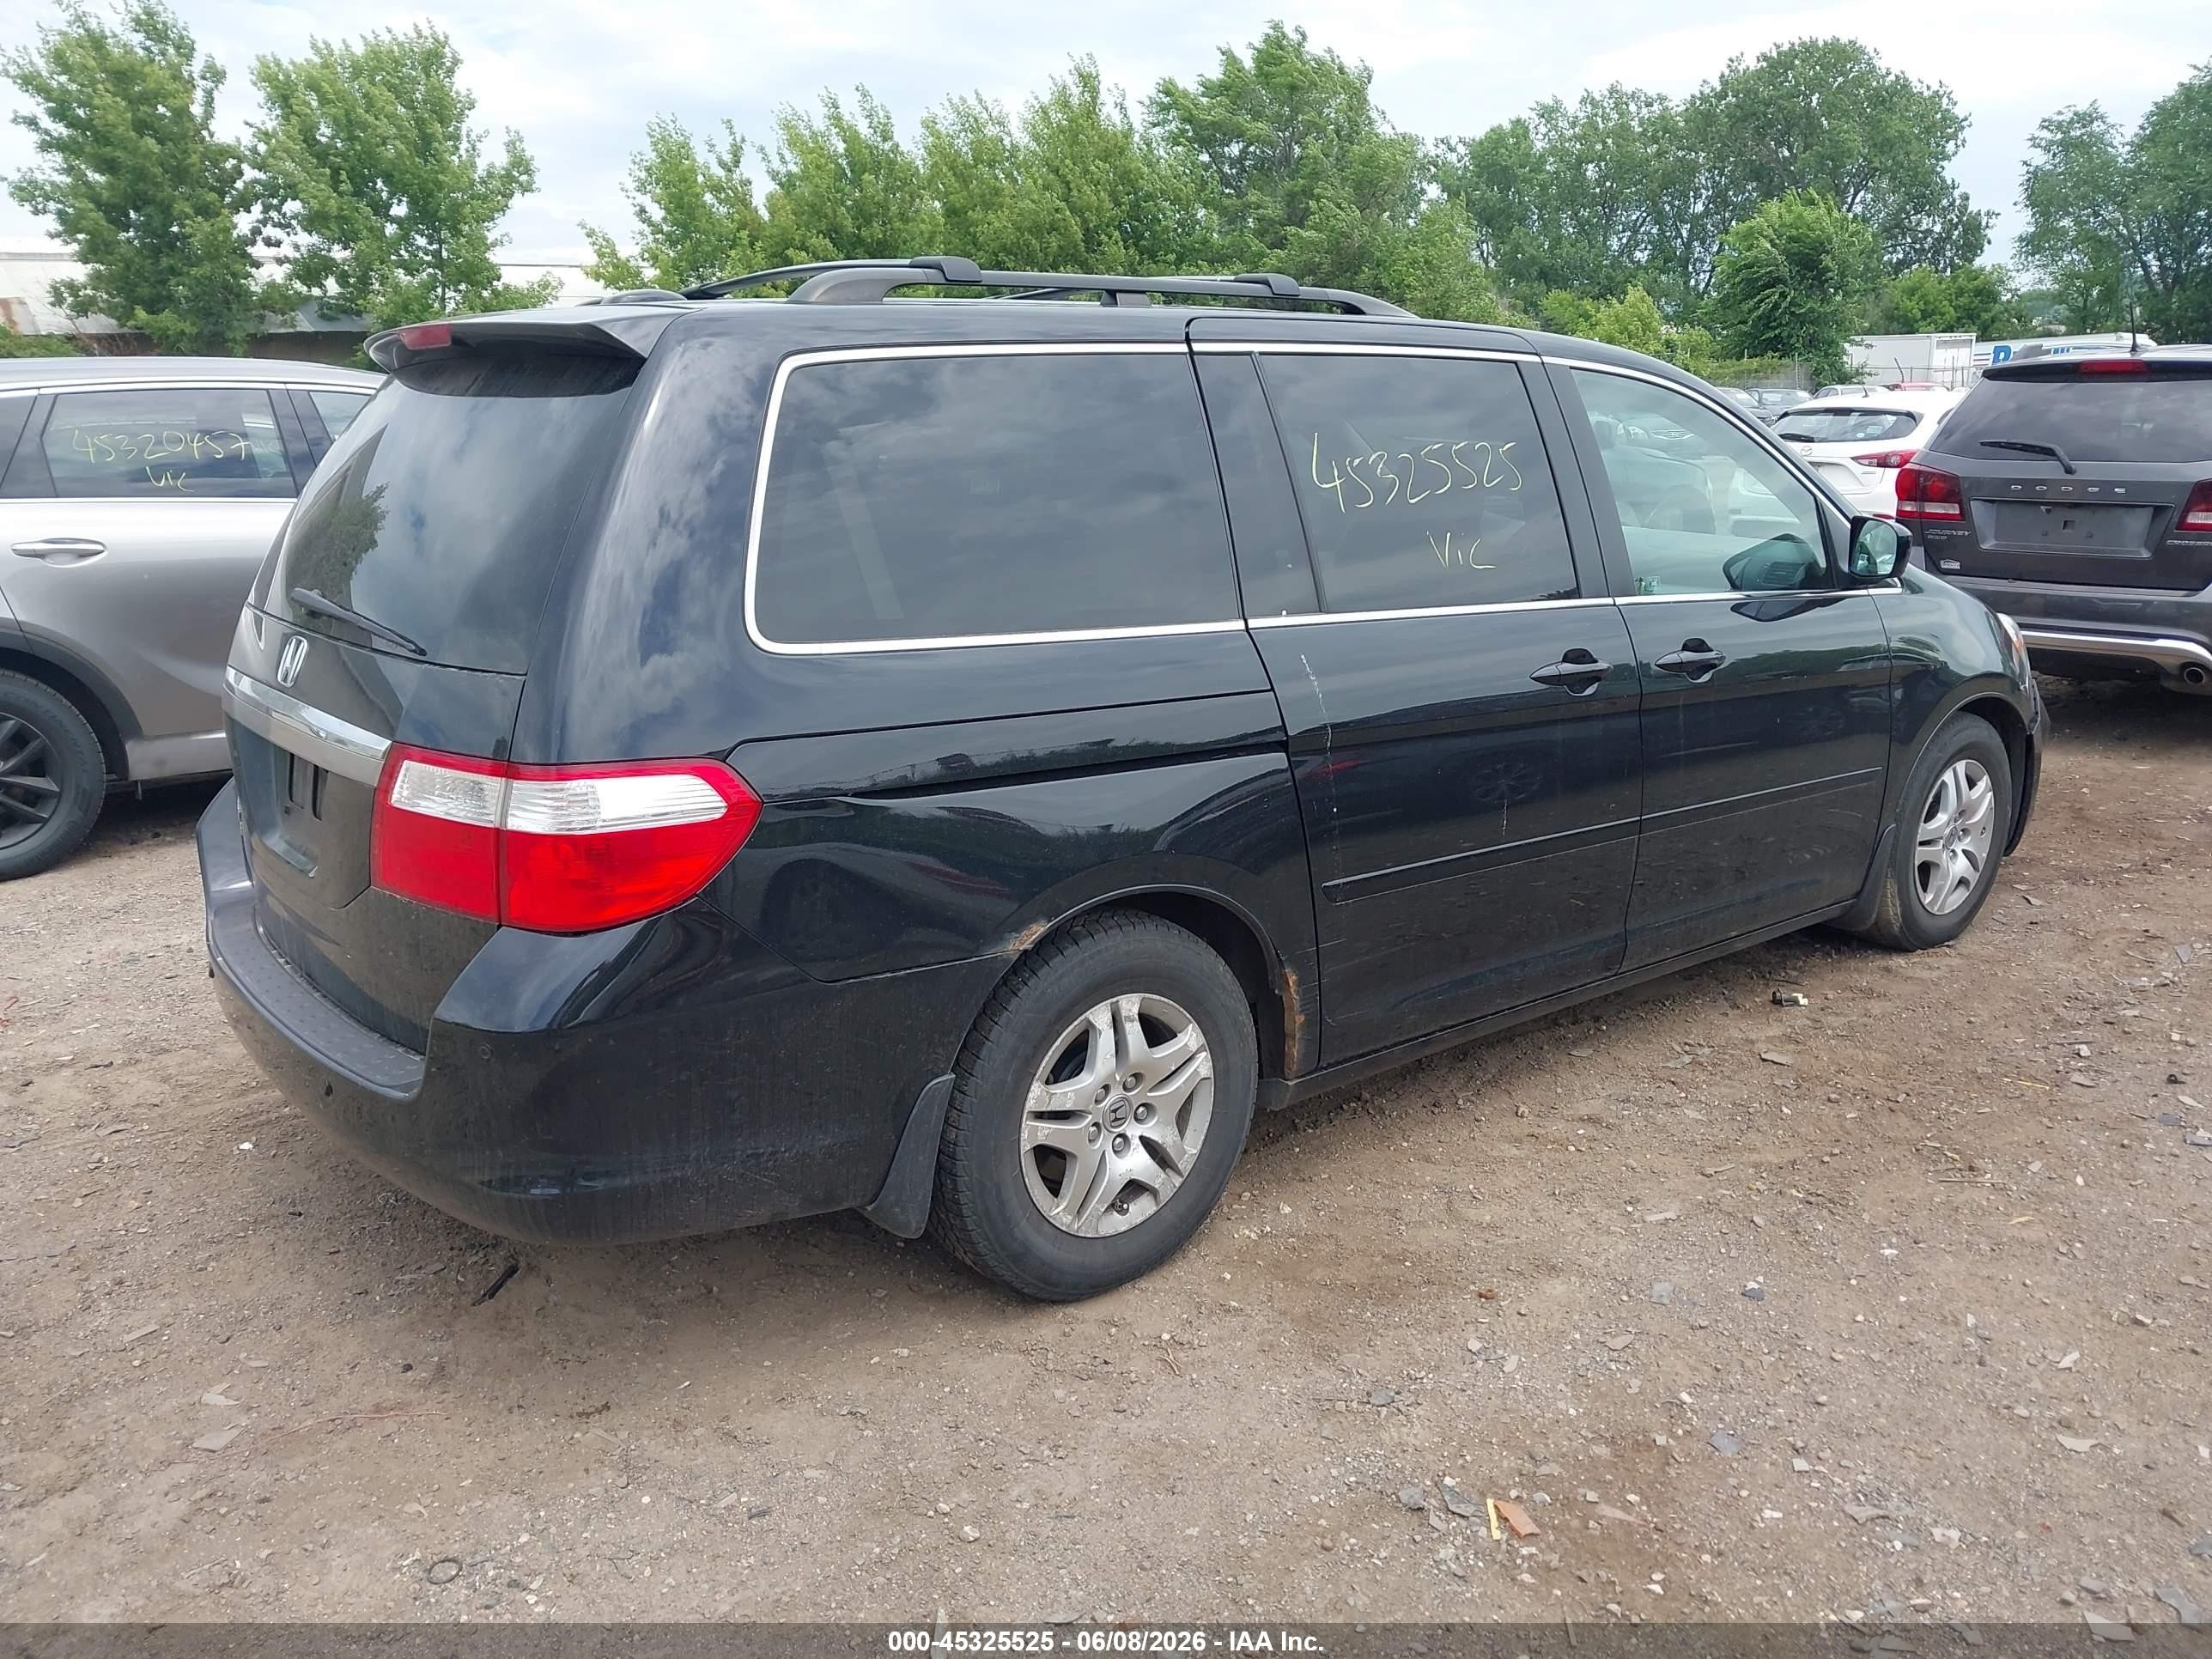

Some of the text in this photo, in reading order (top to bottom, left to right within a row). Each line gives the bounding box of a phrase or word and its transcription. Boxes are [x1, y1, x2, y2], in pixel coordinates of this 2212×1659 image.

[72, 429, 252, 464] 45320457
[1311, 432, 1522, 514] 45325525
[2010, 484, 2127, 495] DODGE
